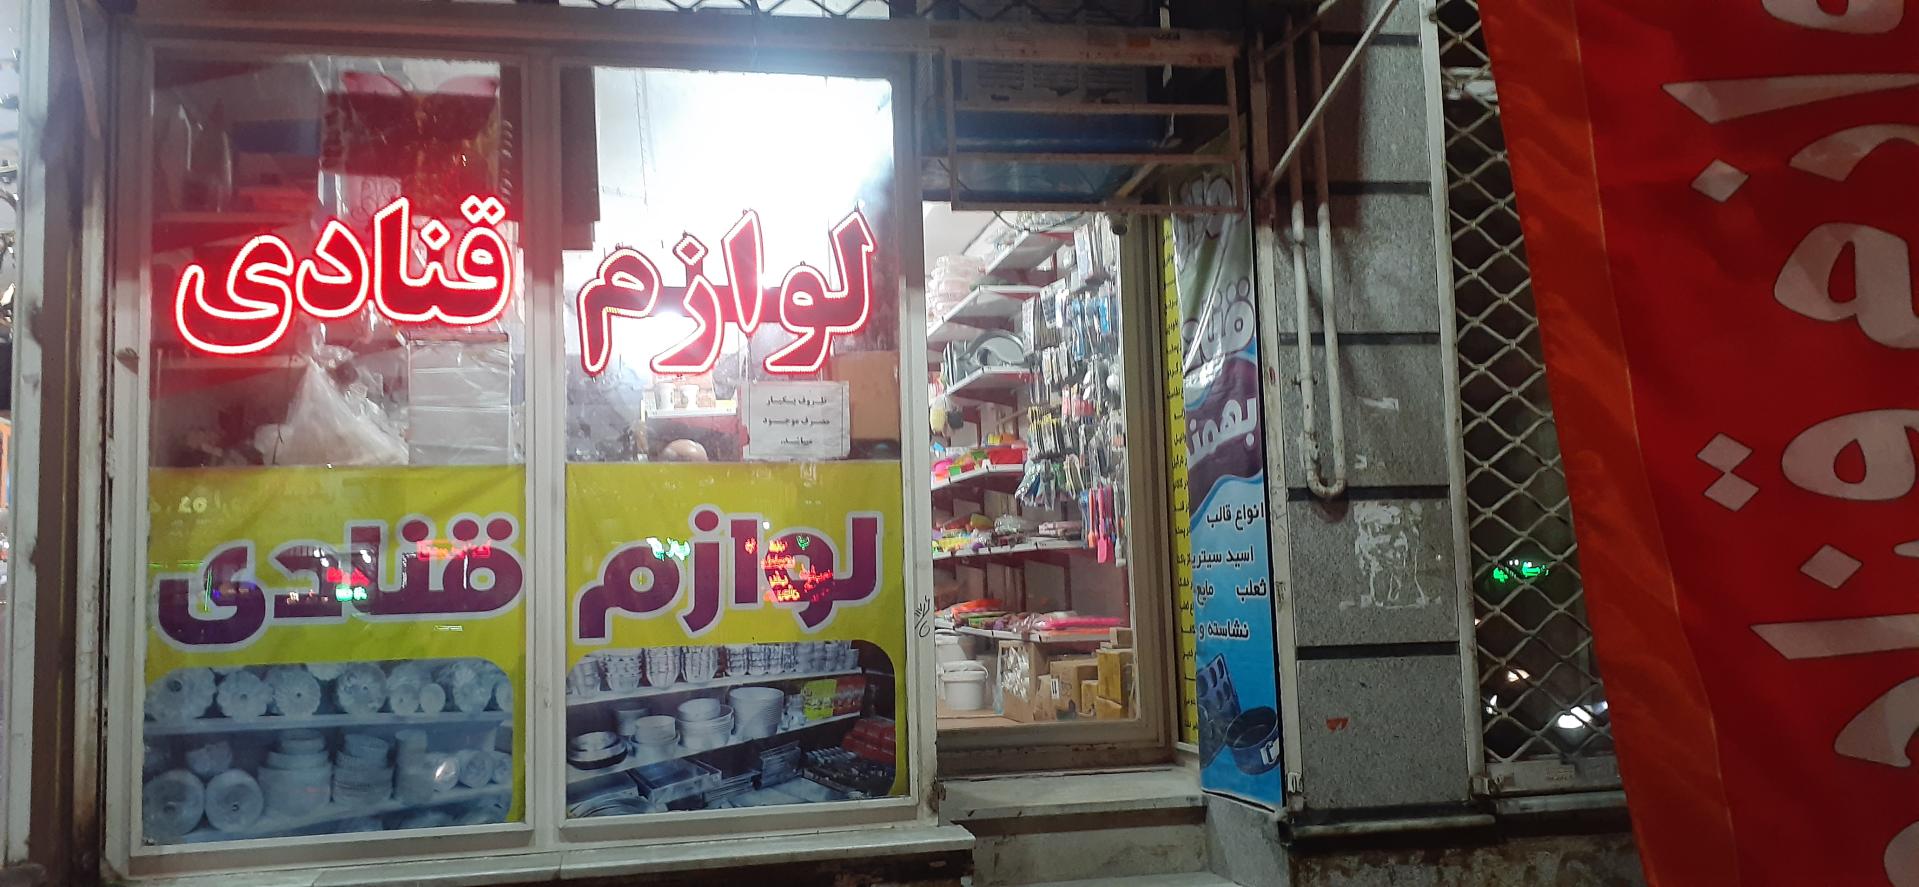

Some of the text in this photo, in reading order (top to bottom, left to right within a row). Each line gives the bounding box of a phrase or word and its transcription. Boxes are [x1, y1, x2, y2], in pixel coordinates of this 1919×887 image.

[174, 194, 876, 377] لوازم قنادی
[1206, 501, 1265, 531] انواع قالب
[1226, 545, 1254, 568] اسید
[154, 514, 525, 650] قنادی
[574, 505, 883, 645] لوازم
[1196, 578, 1267, 605] ثعلب مایع
[1207, 619, 1250, 639] نشاسته
